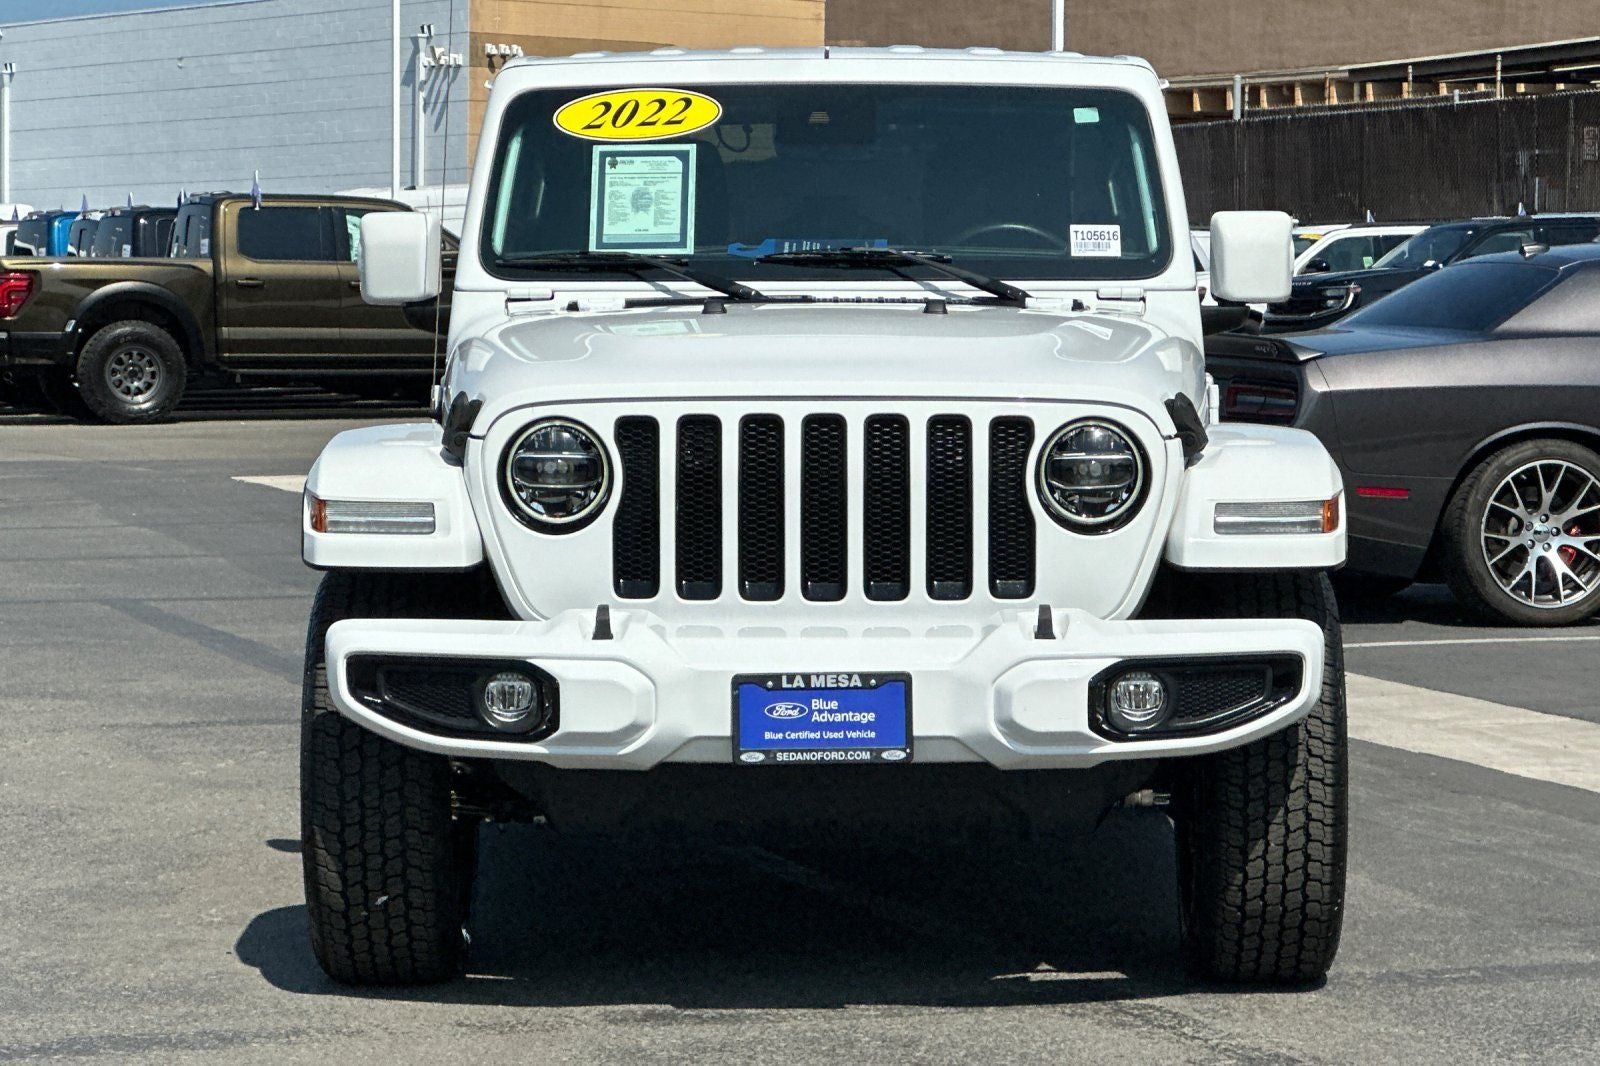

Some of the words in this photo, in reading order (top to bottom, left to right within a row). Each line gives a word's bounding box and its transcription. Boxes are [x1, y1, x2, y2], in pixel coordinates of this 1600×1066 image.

[581, 97, 692, 130] 2022
[1073, 230, 1118, 240] T105616
[781, 674, 805, 688] LA
[810, 674, 863, 688] MESA
[811, 698, 839, 710] Blue
[772, 704, 801, 717] Ford
[811, 711, 876, 724] Advantage
[764, 731, 783, 740] Blue
[785, 730, 820, 739] Certified
[822, 730, 844, 739] Used
[845, 729, 876, 738] Vehicle
[776, 751, 871, 761] SEDANOFORD.COM
